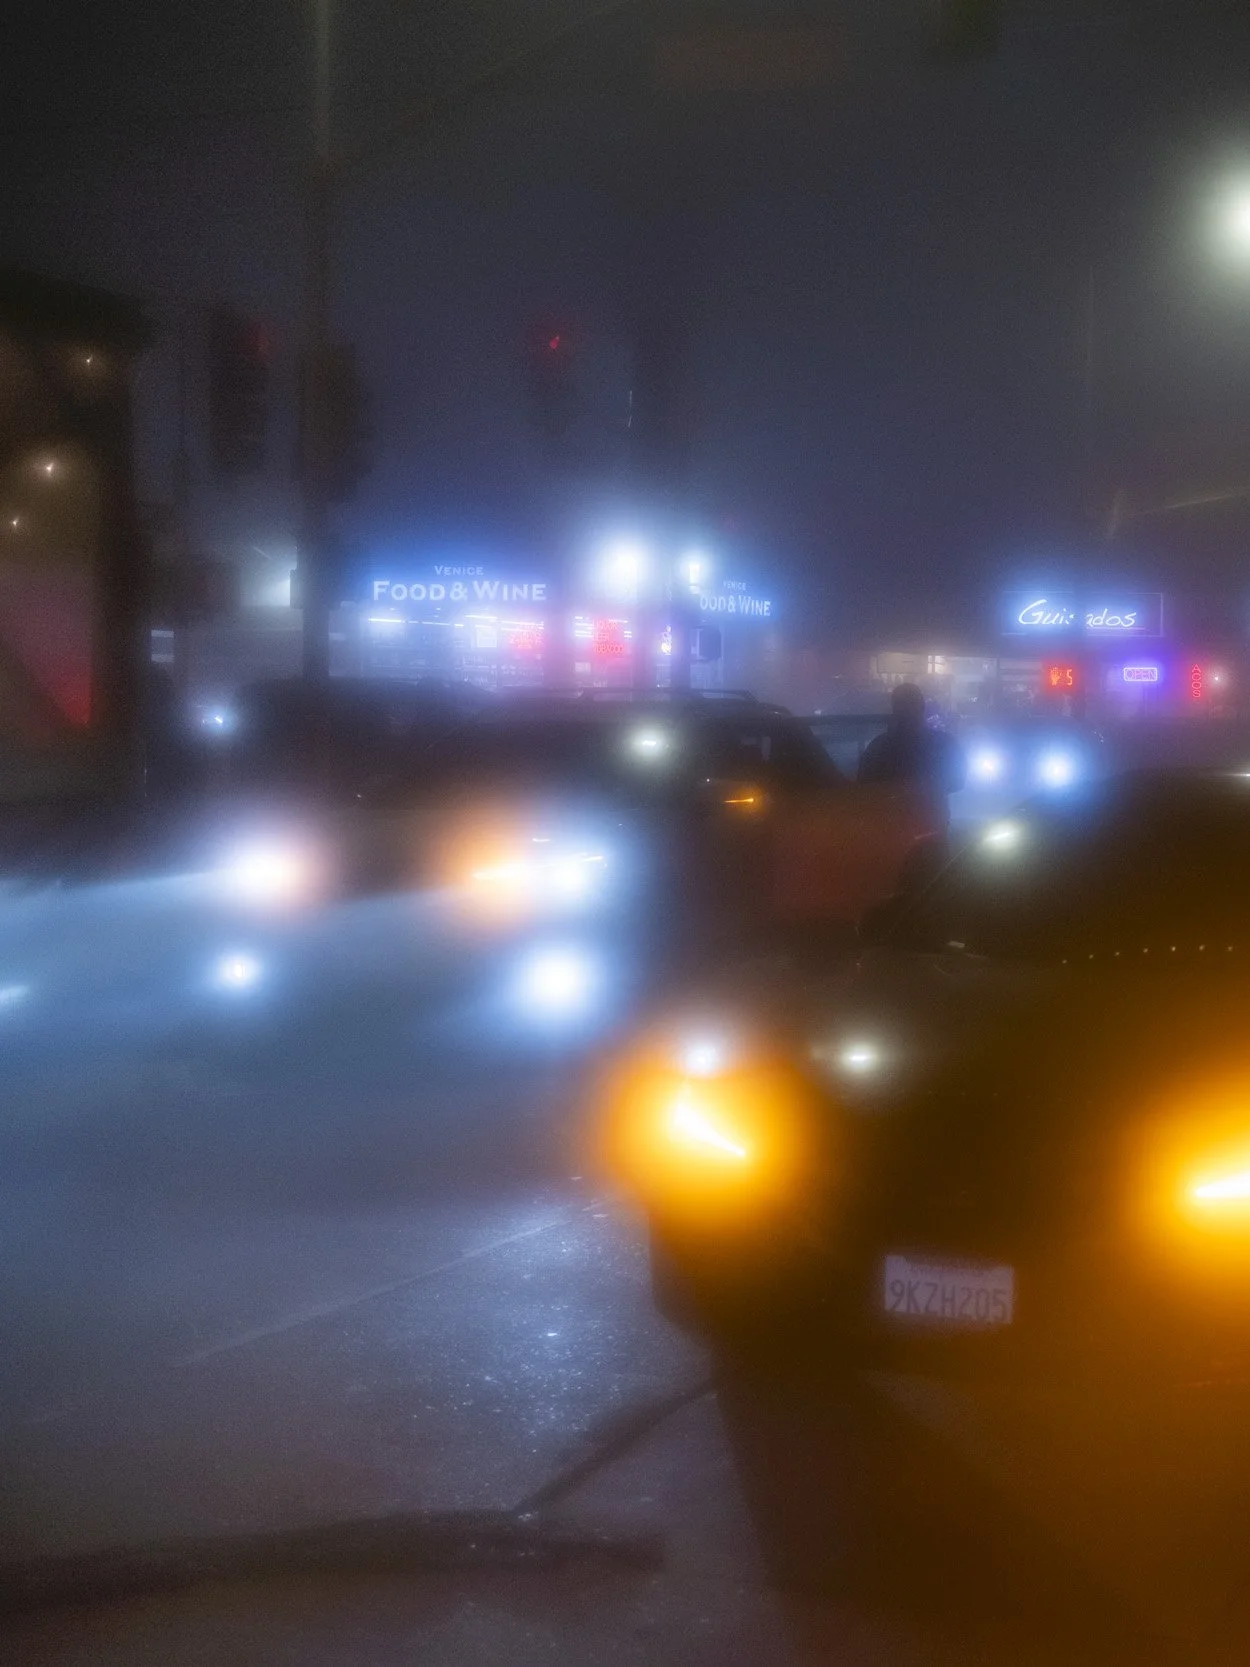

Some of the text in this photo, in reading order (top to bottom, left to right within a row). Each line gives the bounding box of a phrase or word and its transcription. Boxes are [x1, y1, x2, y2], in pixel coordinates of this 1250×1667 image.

[434, 565, 485, 576] VENICE
[373, 580, 547, 601] FOOD & WINE
[699, 594, 772, 617] OOD & WINE
[1066, 668, 1073, 686] 5
[1126, 669, 1155, 680] OPEN
[889, 1279, 1007, 1322] 9KZH205
